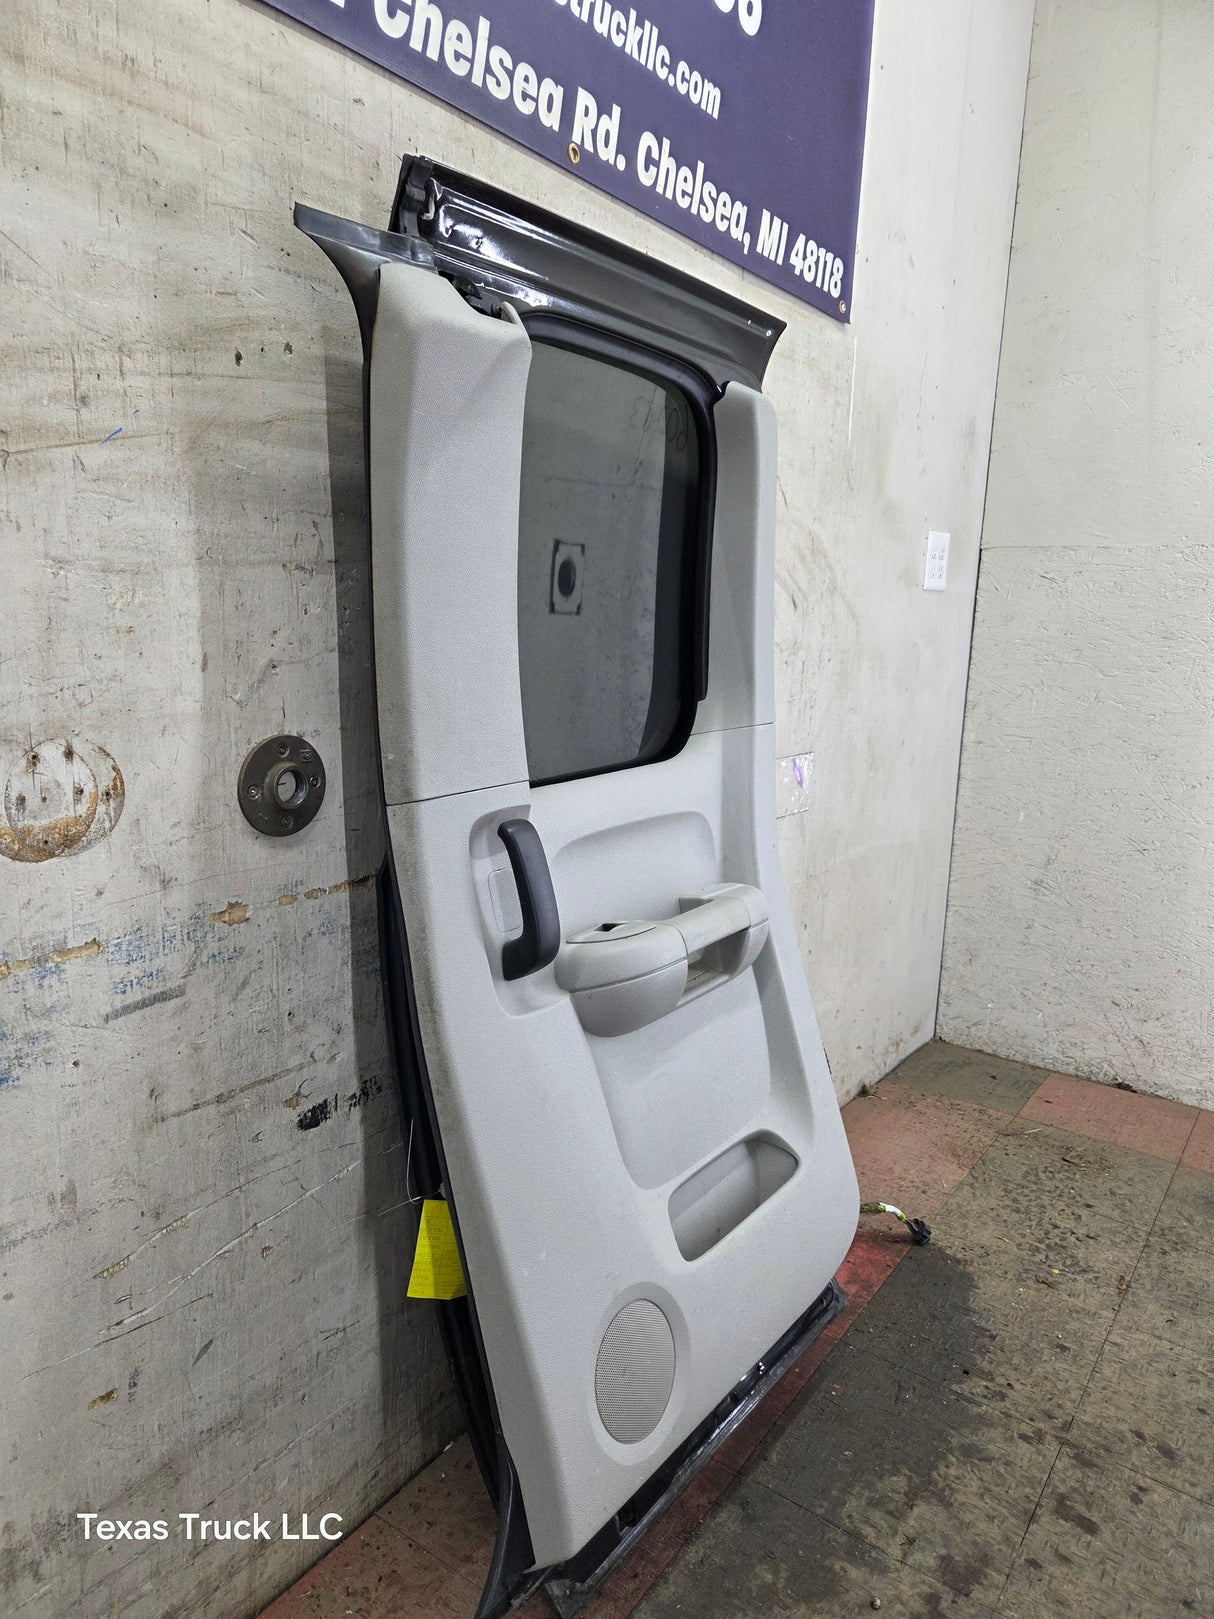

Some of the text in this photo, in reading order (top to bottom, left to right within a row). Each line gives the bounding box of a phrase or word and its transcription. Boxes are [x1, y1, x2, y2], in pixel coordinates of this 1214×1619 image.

[374, 0, 844, 299] Chelsea Rd. Chelsea, MI 48118
[555, 0, 721, 120] ruckllc.com
